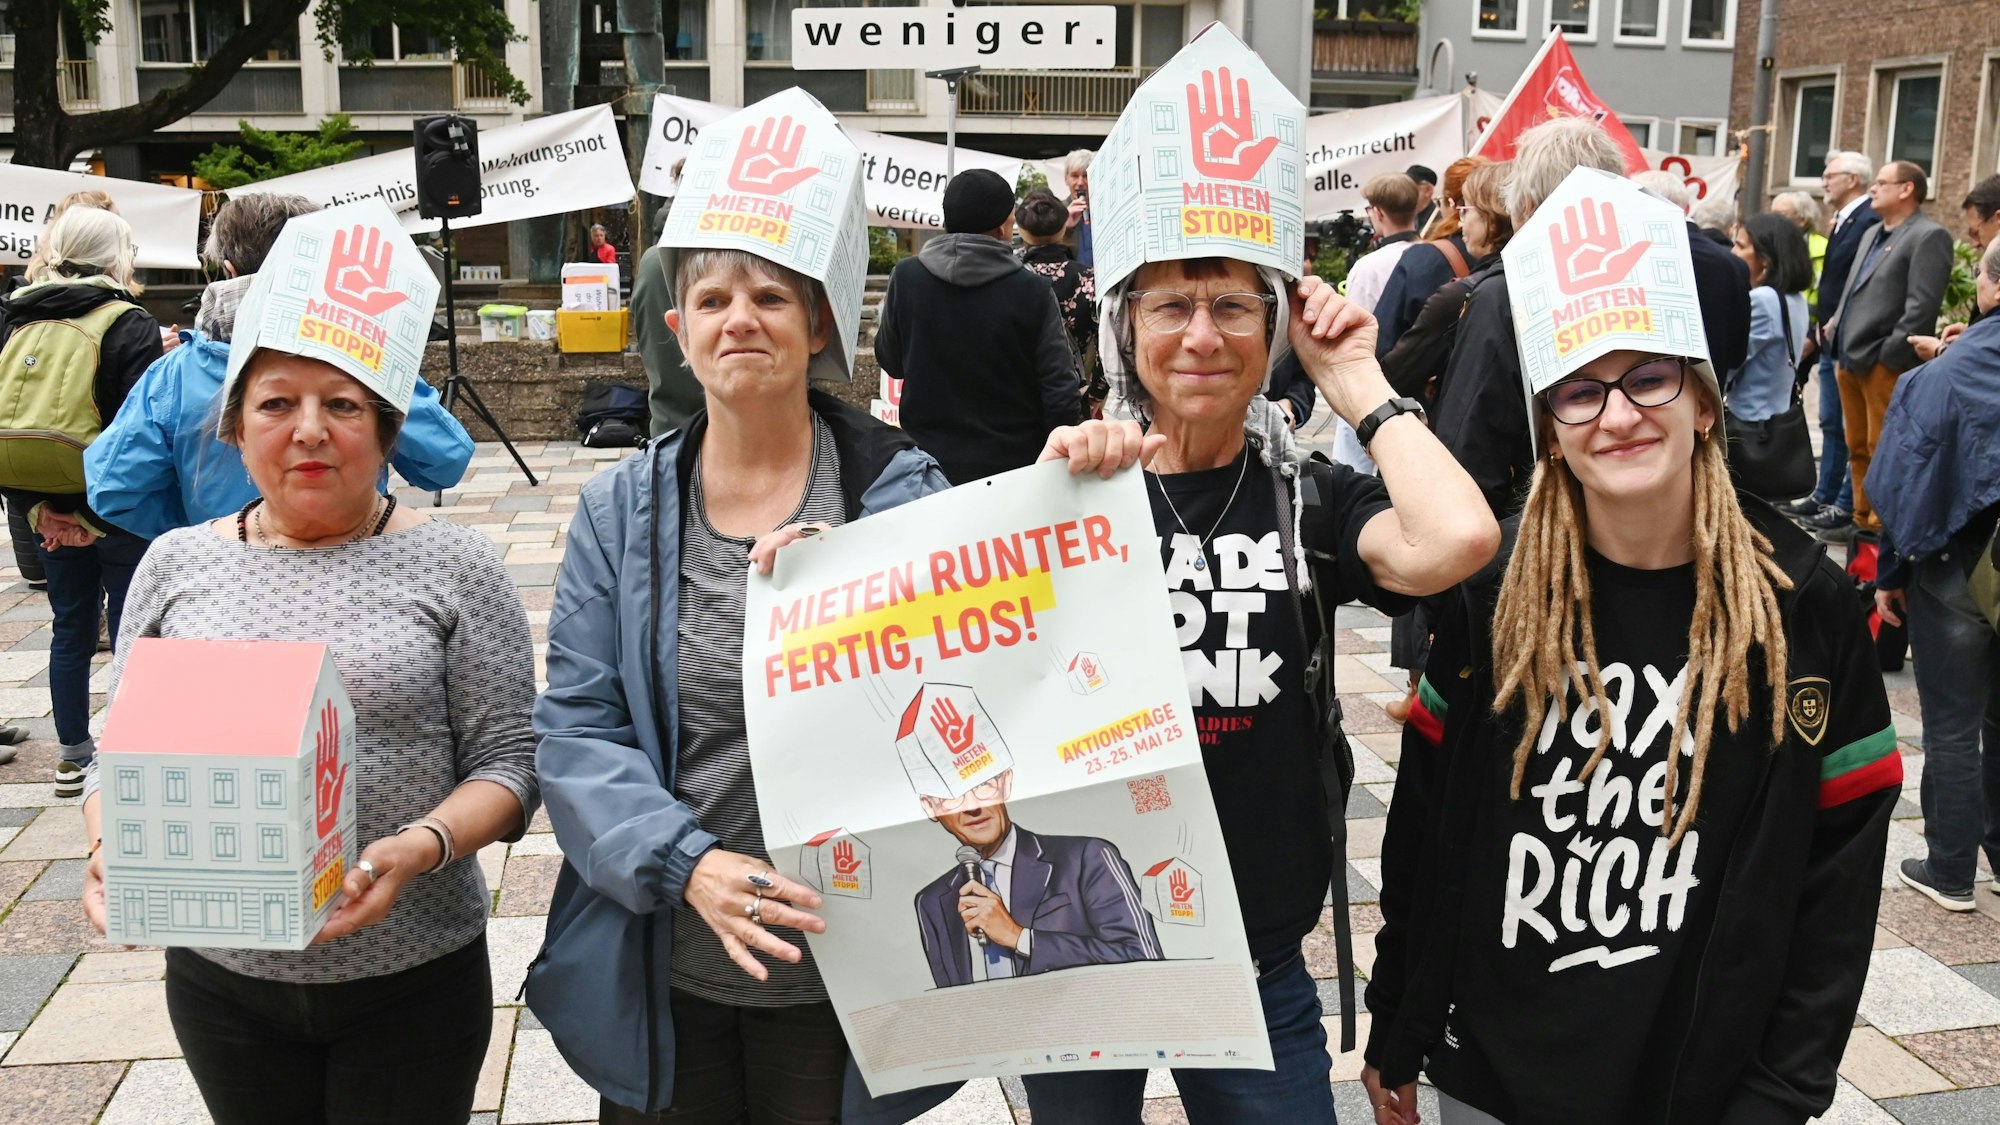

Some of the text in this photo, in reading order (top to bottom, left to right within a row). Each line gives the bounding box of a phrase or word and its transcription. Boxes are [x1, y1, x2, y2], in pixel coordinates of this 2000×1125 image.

[805, 12, 1103, 54] weniger.
[481, 133, 606, 174] Wohnungsnot
[1183, 182, 1270, 214] MIETEN
[1314, 169, 1359, 191] alle.
[0, 203, 35, 223] ne
[700, 213, 787, 243] STOPP!
[706, 193, 793, 222] MIETEN
[876, 203, 945, 229] vertre
[1184, 210, 1271, 243] STOPP!
[306, 298, 387, 348] MIETEN
[1552, 287, 1647, 329] MIETEN
[301, 319, 382, 369] STOPP!
[1557, 310, 1650, 353] STOPP!
[768, 514, 1128, 641] MIETEN RUNTER,
[764, 596, 1038, 697] FERTIG, LOS!
[1062, 702, 1176, 763] AKTIONSTAGE
[1085, 724, 1182, 775] 23.-25. MAI 25
[952, 742, 987, 769] MIETEN
[959, 753, 993, 779] STOPP!
[1531, 757, 1679, 832] the
[313, 829, 342, 874] MIETEN
[313, 857, 343, 909] STOPP!
